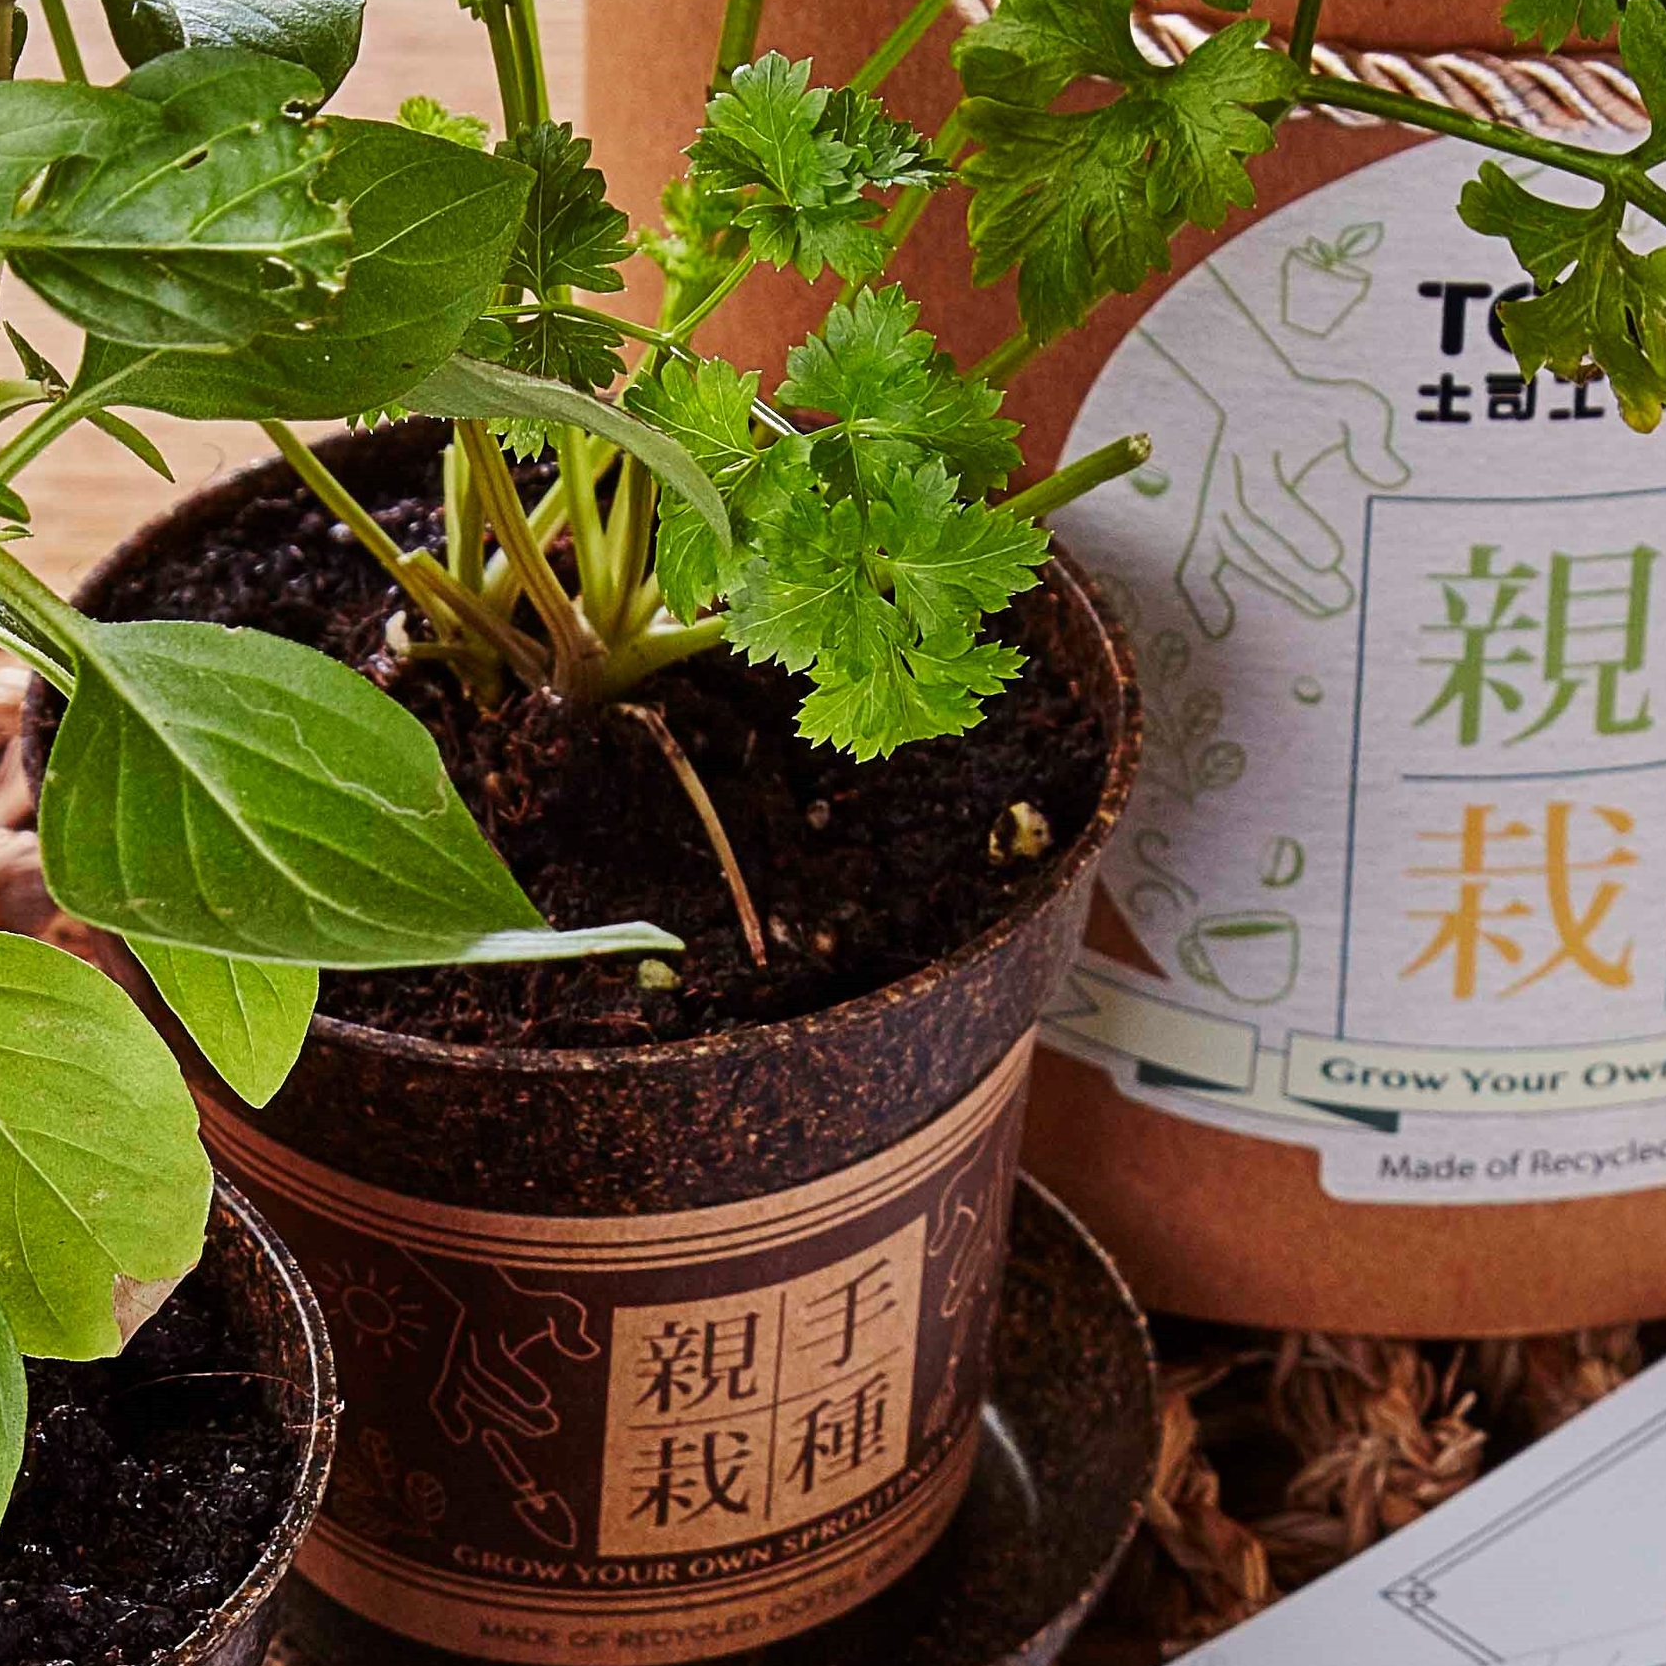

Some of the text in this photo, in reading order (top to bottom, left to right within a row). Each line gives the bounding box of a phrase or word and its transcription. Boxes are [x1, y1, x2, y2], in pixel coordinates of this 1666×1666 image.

[1415, 371, 1609, 423] 土司工
[1319, 1055, 1450, 1094] Grow
[1461, 1067, 1566, 1096] Your
[1379, 1153, 1476, 1181] Made
[1487, 1150, 1521, 1178] of
[452, 1544, 566, 1582] GROW
[573, 1559, 678, 1583] YOUR
[688, 1543, 773, 1580] OWN
